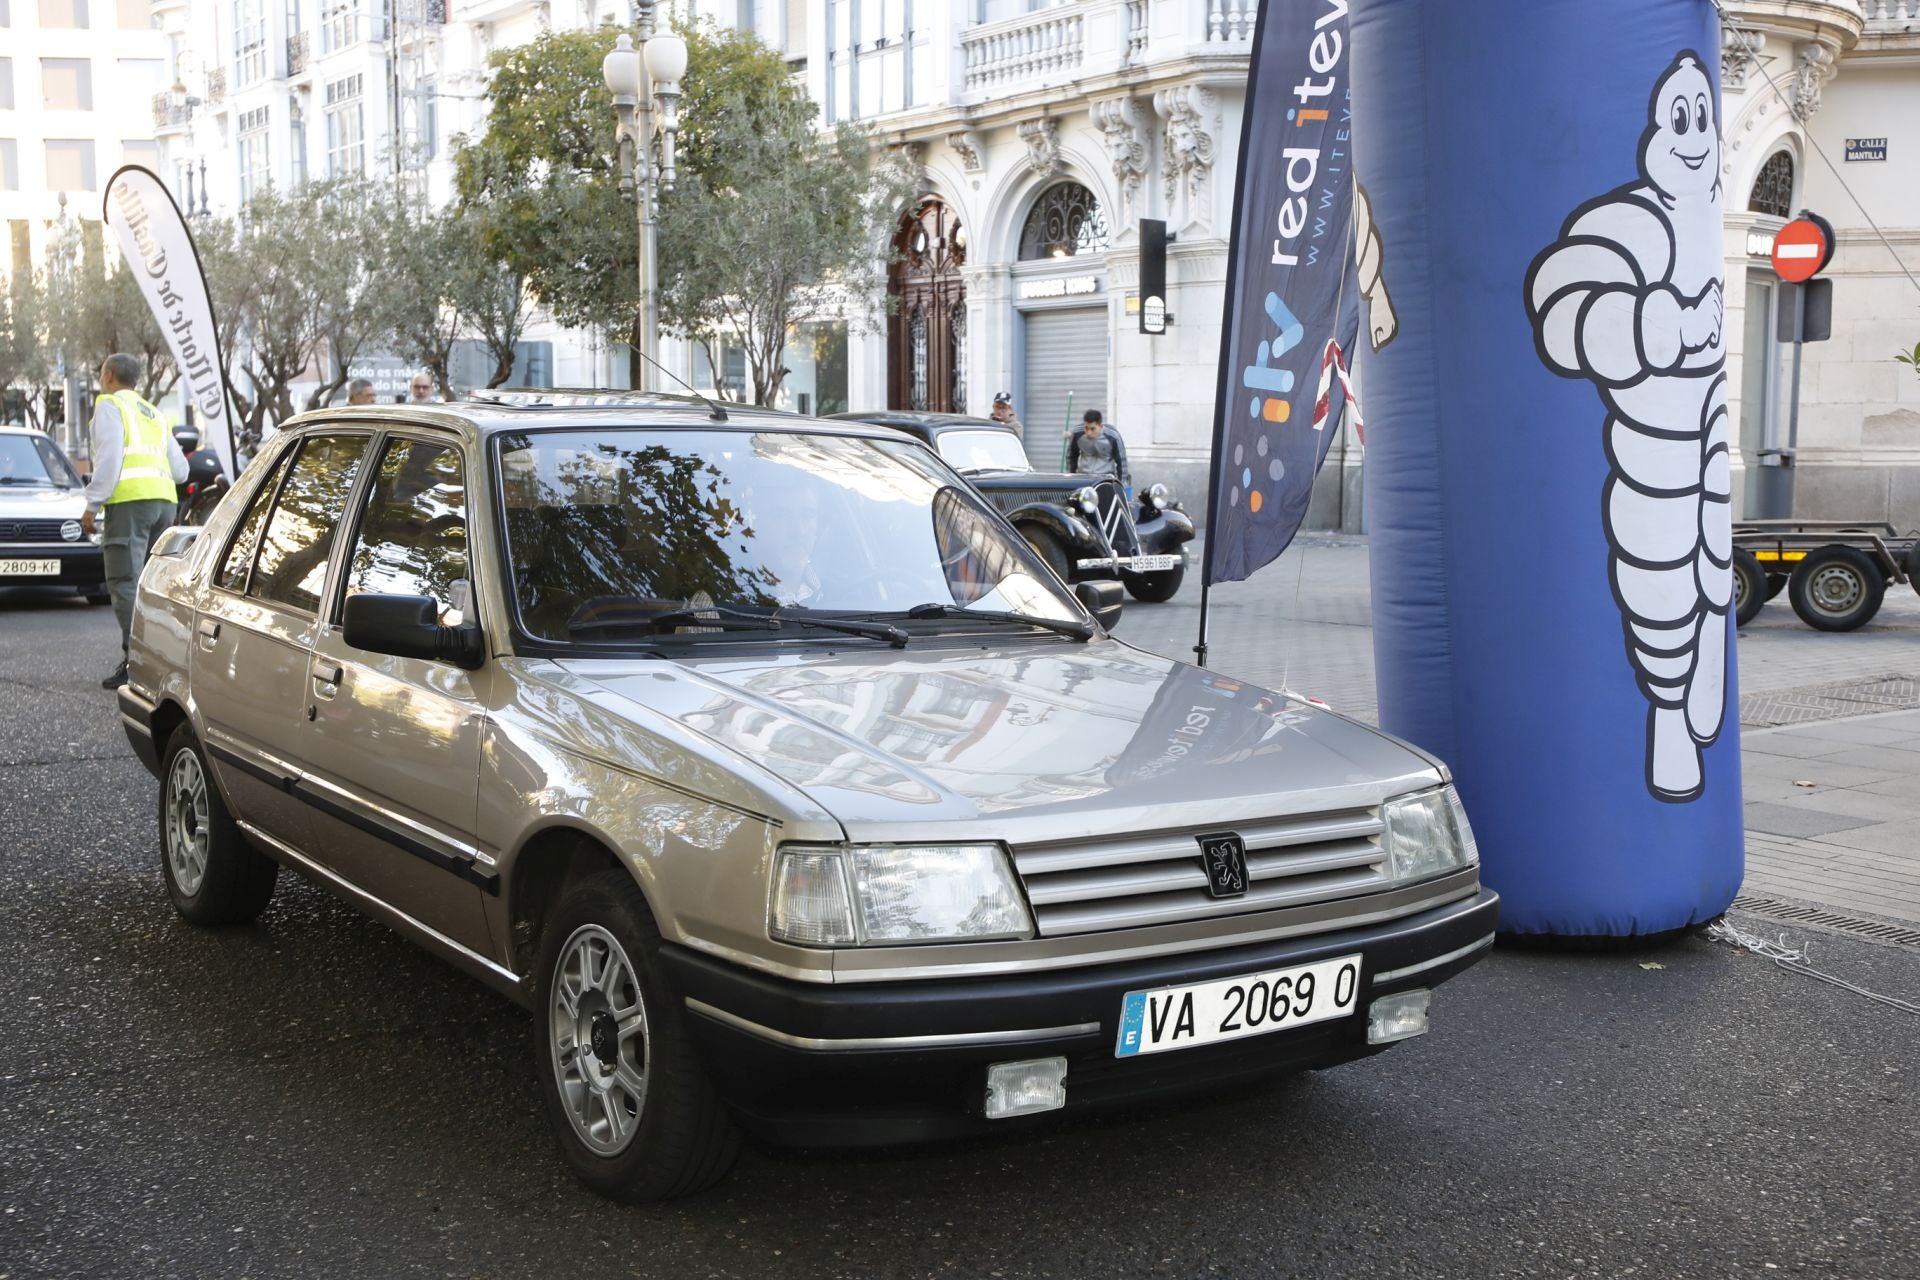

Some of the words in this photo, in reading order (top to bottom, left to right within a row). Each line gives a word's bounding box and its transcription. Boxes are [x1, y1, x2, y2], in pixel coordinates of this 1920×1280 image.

[1859, 139, 1886, 148] CALLE
[1848, 151, 1884, 160] MANTILLA
[1271, 147, 1321, 266] red
[1149, 991, 1195, 1043] VA
[1219, 971, 1316, 1033] 2069
[1125, 1031, 1136, 1045] E
